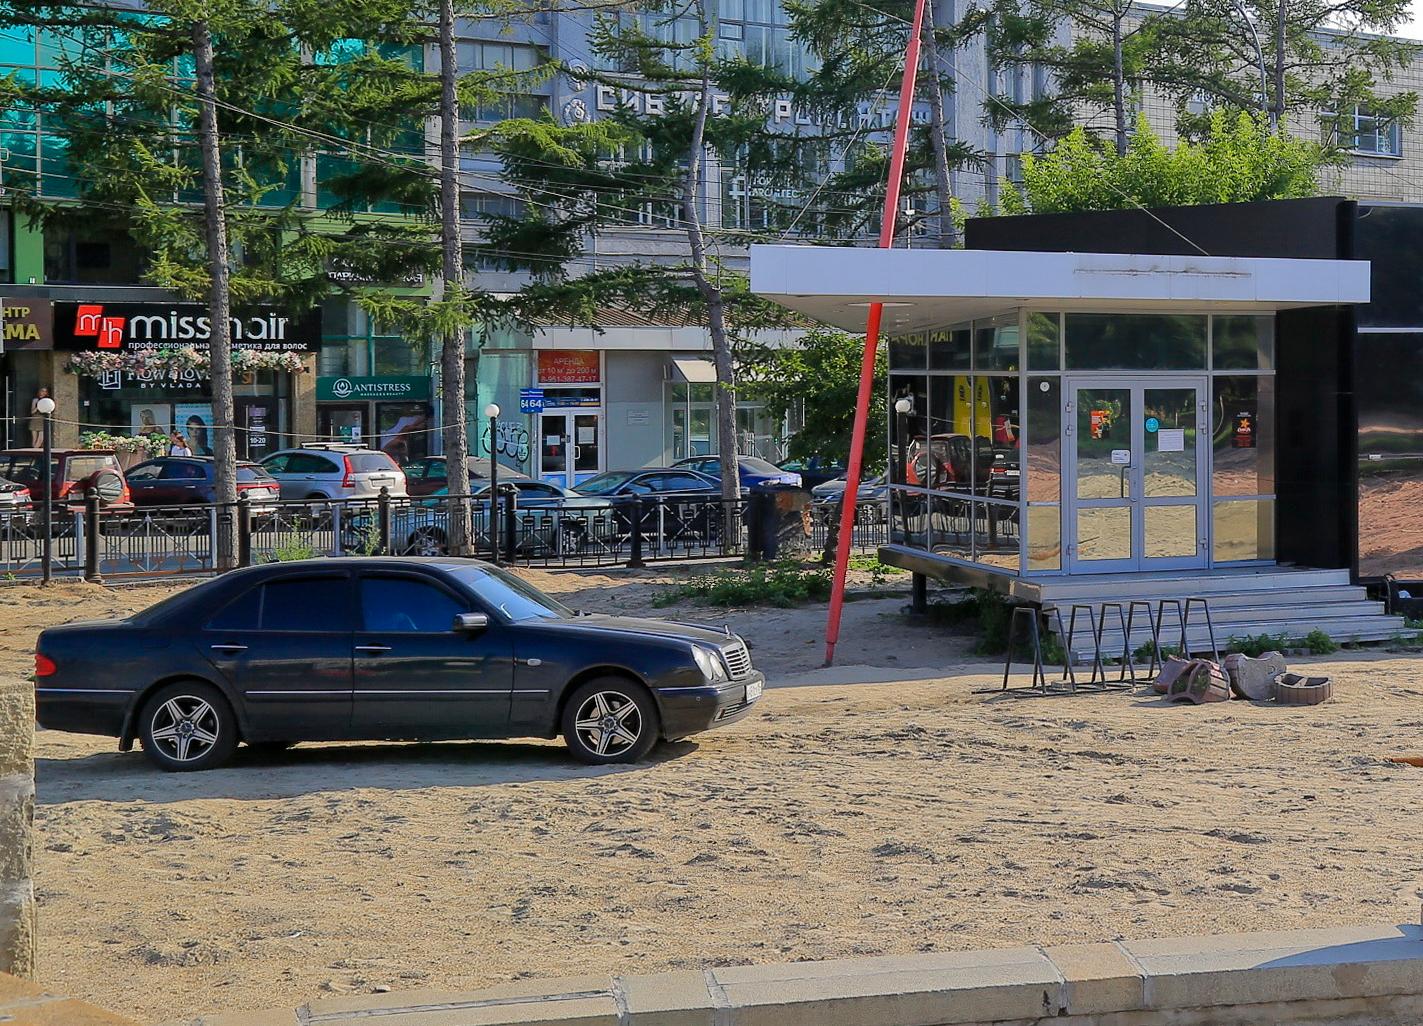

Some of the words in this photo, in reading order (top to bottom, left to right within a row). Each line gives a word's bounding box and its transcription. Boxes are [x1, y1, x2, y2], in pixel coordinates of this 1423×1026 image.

[264, 343, 281, 351] для
[283, 343, 308, 351] волос
[554, 357, 585, 365] АРЕНДА
[353, 383, 411, 392] ANTISTRESS
[530, 399, 542, 408] 64
